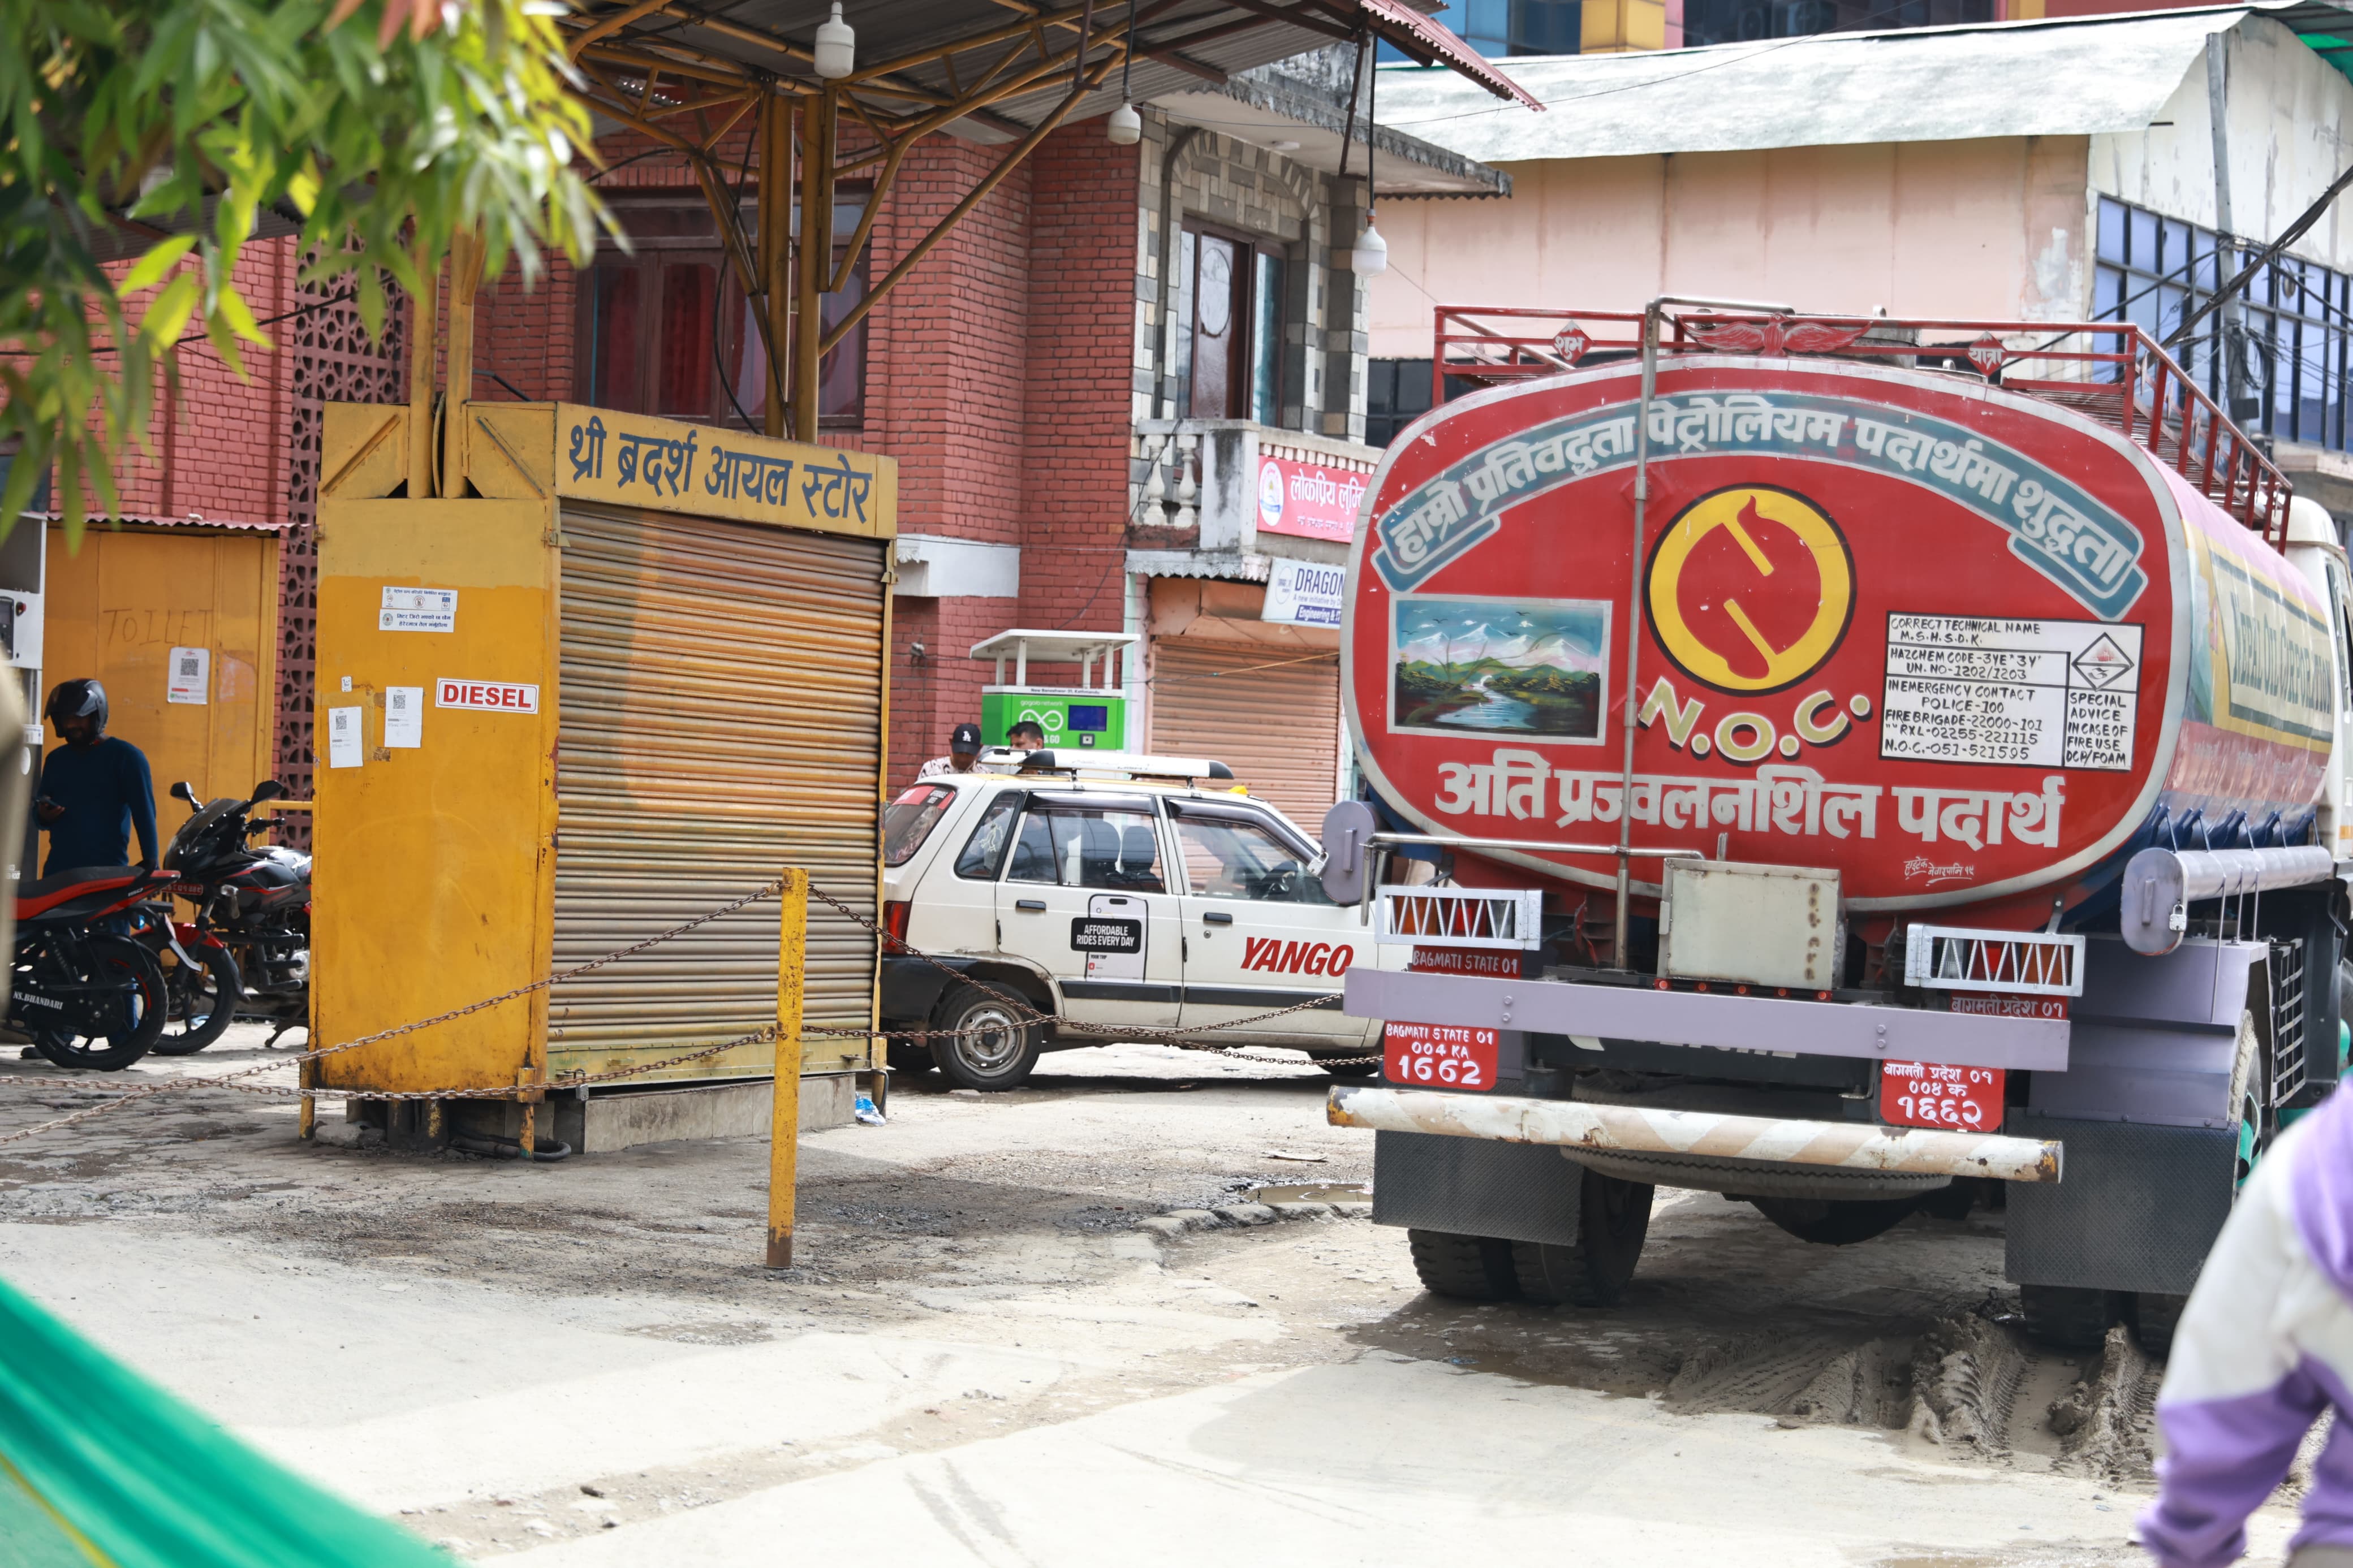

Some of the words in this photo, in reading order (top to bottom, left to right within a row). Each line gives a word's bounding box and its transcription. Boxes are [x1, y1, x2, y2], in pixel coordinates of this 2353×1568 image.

[1554, 336, 1585, 360] शुभ
[1968, 347, 2006, 370] यात्रा
[705, 446, 794, 507] आयल
[801, 453, 873, 524] स्टोर
[1290, 468, 1336, 507] लोकप्रिय
[1648, 396, 1848, 453] पेट्रोलियम
[1854, 417, 2019, 506] पदार्थमा
[2012, 478, 2132, 585] शुद्धता
[1298, 606, 1330, 623] Engineering
[1891, 617, 1941, 630] CORRECT
[1945, 619, 2001, 633] TECHNICAL
[2005, 623, 2041, 634] NAME
[102, 608, 213, 646] TOILET
[1890, 647, 1944, 662] HAZCHEM
[2231, 591, 2262, 691] NEPAL
[2264, 612, 2279, 697] OIL
[443, 684, 532, 709] DIESEL
[1888, 680, 1901, 691] IN
[1901, 680, 1971, 697] EMERGENCY
[1975, 686, 2036, 701] CONTACT
[2070, 692, 2127, 708] SPECIAL
[1638, 675, 1872, 764] N.O.C.
[1885, 709, 1910, 723] FIRE
[2070, 707, 2121, 722] ADVICE
[1050, 735, 1060, 744] GO
[2067, 722, 2079, 735] IN
[2081, 723, 2111, 736] CASE
[2112, 725, 2128, 738] OF
[2066, 736, 2093, 748] FIRE
[2095, 738, 2121, 751] USE
[1434, 748, 1552, 821] अति
[1891, 775, 2066, 852] पदार्थ
[1076, 935, 1097, 945] RIDES
[1098, 936, 1120, 946] EVERY
[1121, 936, 1135, 947] DAY
[1084, 924, 1128, 936] AFFORDABLE
[1240, 936, 1354, 977] YANGO
[1412, 949, 1462, 970] BAGMATI
[1465, 954, 1499, 974] STATE
[1501, 958, 1518, 975] 01
[1951, 994, 2001, 1016] बागमती
[2001, 997, 2039, 1018] प्रदेश
[2042, 1001, 2063, 1018] ०१
[1386, 1023, 1429, 1040] BAGMATI
[1432, 1027, 1469, 1043] STATE
[1476, 1030, 1494, 1045] 01
[1411, 1042, 1446, 1057] 004
[1451, 1044, 1469, 1059] KA
[1398, 1055, 1481, 1085] 1662
[1884, 1062, 1925, 1079] बागमती
[1928, 1066, 1961, 1083] प्रदेश
[1970, 1069, 1992, 1086] ०१
[1908, 1081, 1942, 1097] ००४
[1947, 1082, 1968, 1098] क
[1897, 1096, 1983, 1130] १६६२
